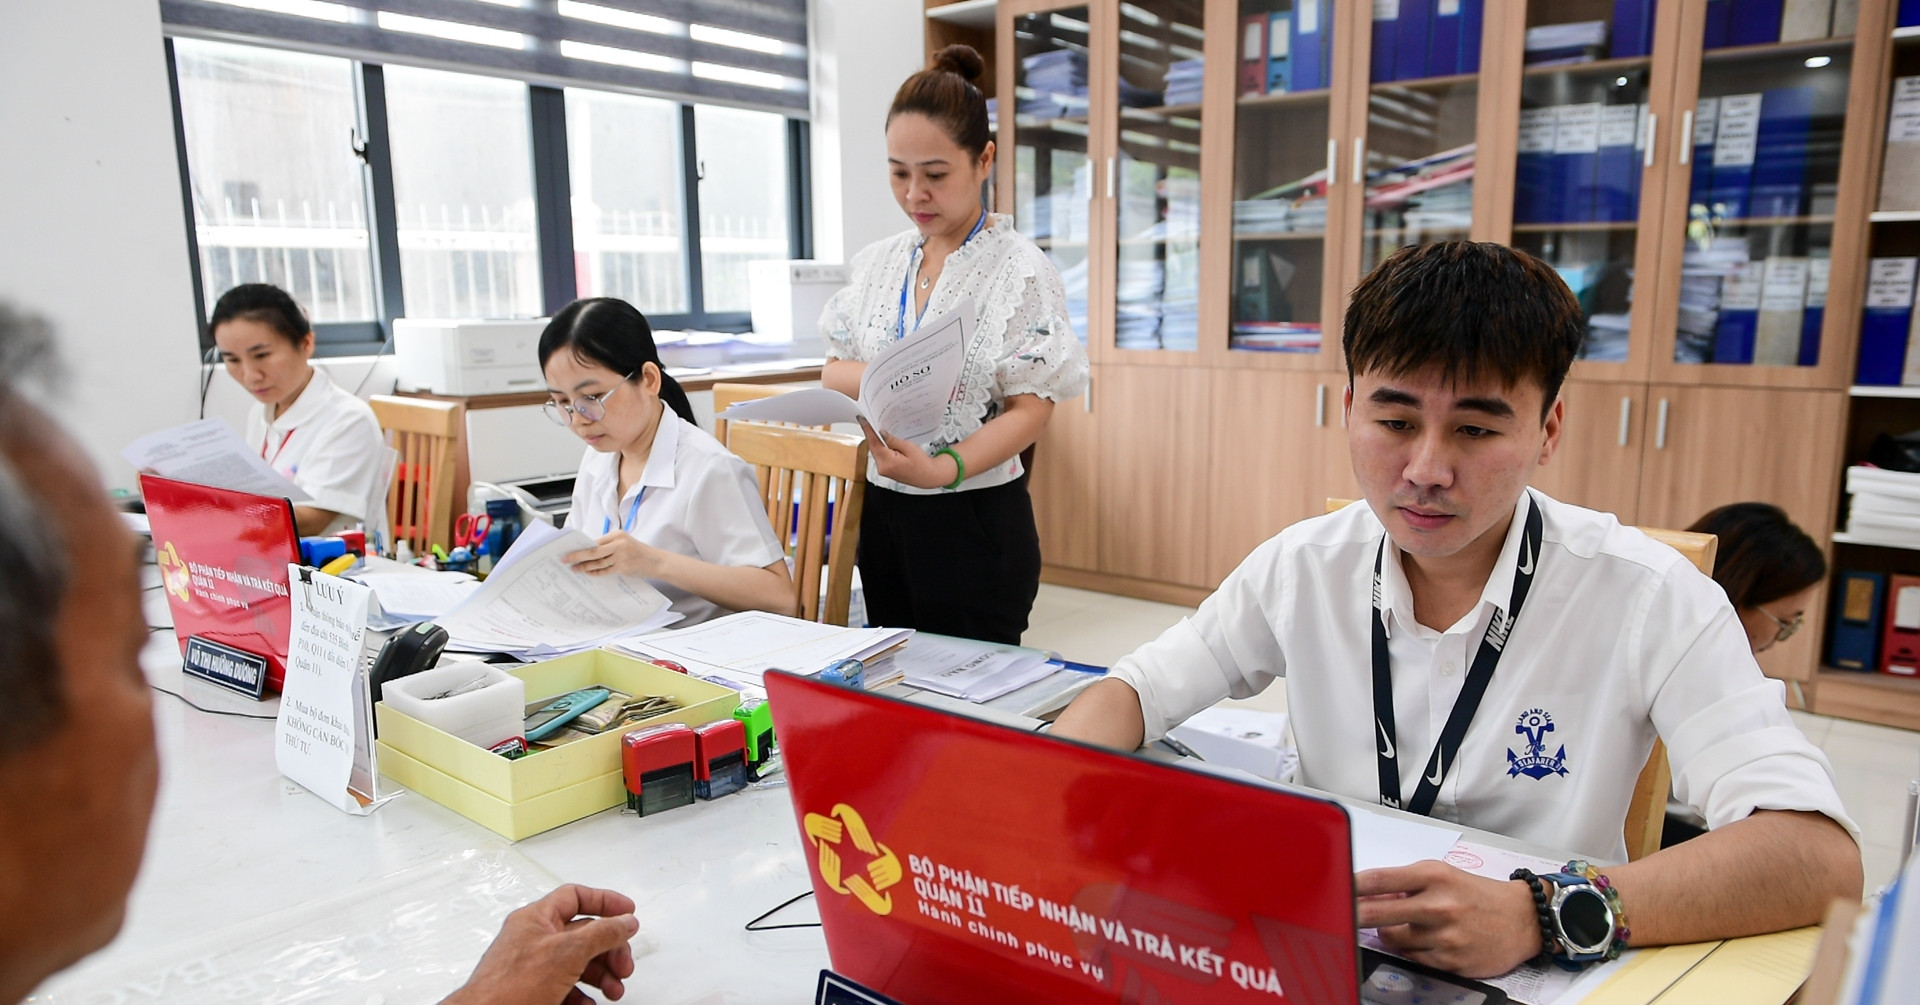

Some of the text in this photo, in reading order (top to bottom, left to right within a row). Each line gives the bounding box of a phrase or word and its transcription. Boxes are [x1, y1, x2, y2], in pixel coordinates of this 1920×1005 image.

[197, 563, 214, 577] PHẬN
[213, 567, 226, 580] TIẾP
[226, 570, 243, 586] NHẬN
[250, 576, 263, 590] TRẢ
[262, 579, 275, 593] KẾT
[274, 583, 289, 597] QUẢ
[315, 581, 344, 605] LƯU Ý
[200, 651, 212, 674] THỊ
[286, 714, 312, 736] KHÔNG
[1517, 711, 1529, 725] LAND
[1542, 712, 1552, 724] SEA
[913, 876, 987, 918] QUẬN 11
[908, 853, 1284, 997] BỘ PHẬN TIẾP NHẬN VÀ TRẢ KẾT QUẢ
[917, 900, 1104, 982] Hành chính phục vụ
